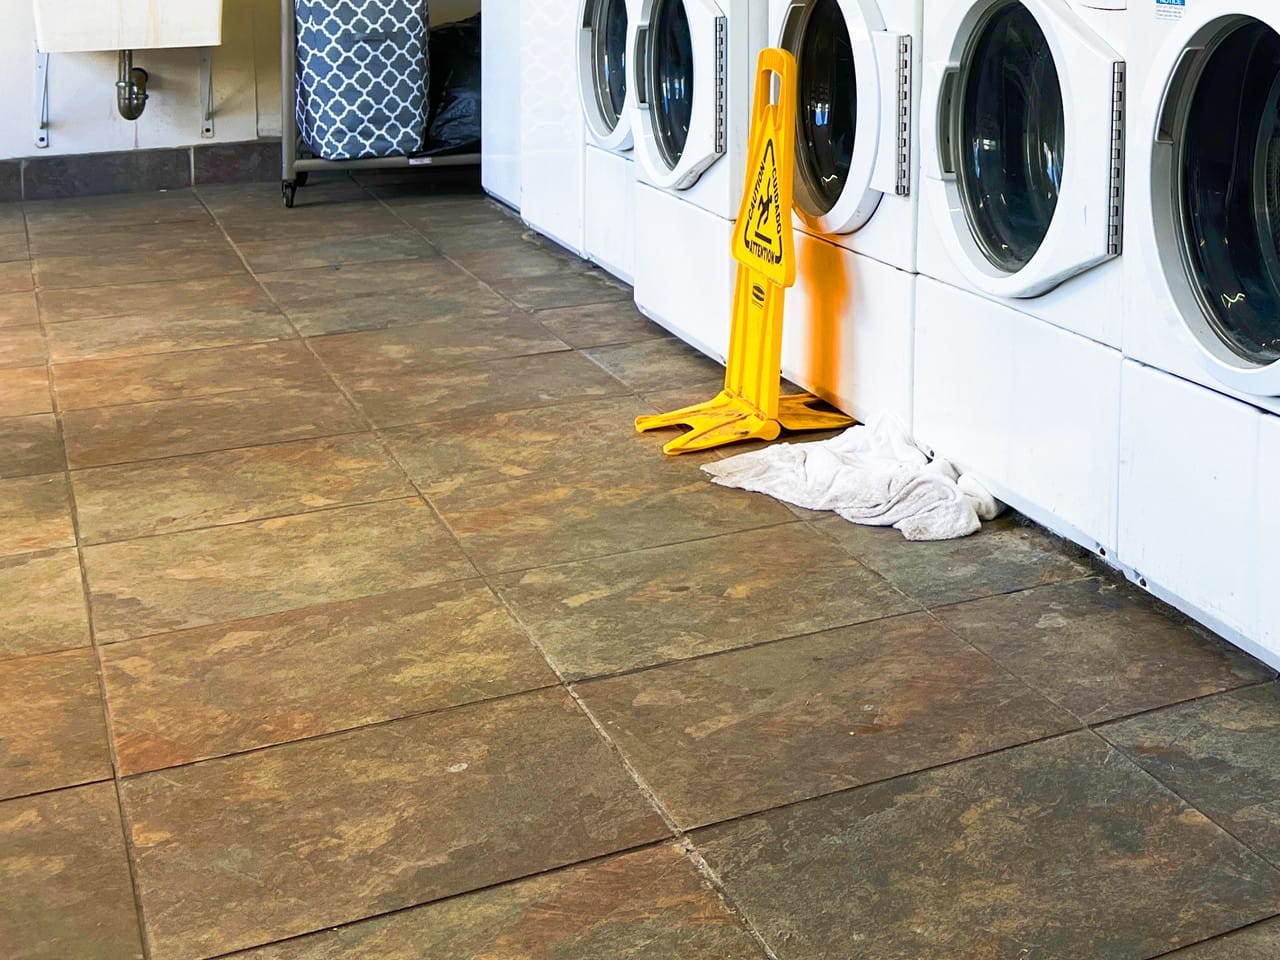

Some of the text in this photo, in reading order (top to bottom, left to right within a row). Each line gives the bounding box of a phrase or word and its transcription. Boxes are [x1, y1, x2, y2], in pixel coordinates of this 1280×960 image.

[748, 161, 765, 221] CAUTION
[771, 167, 782, 234] CUIDADO
[749, 240, 776, 265] ATTENTION
